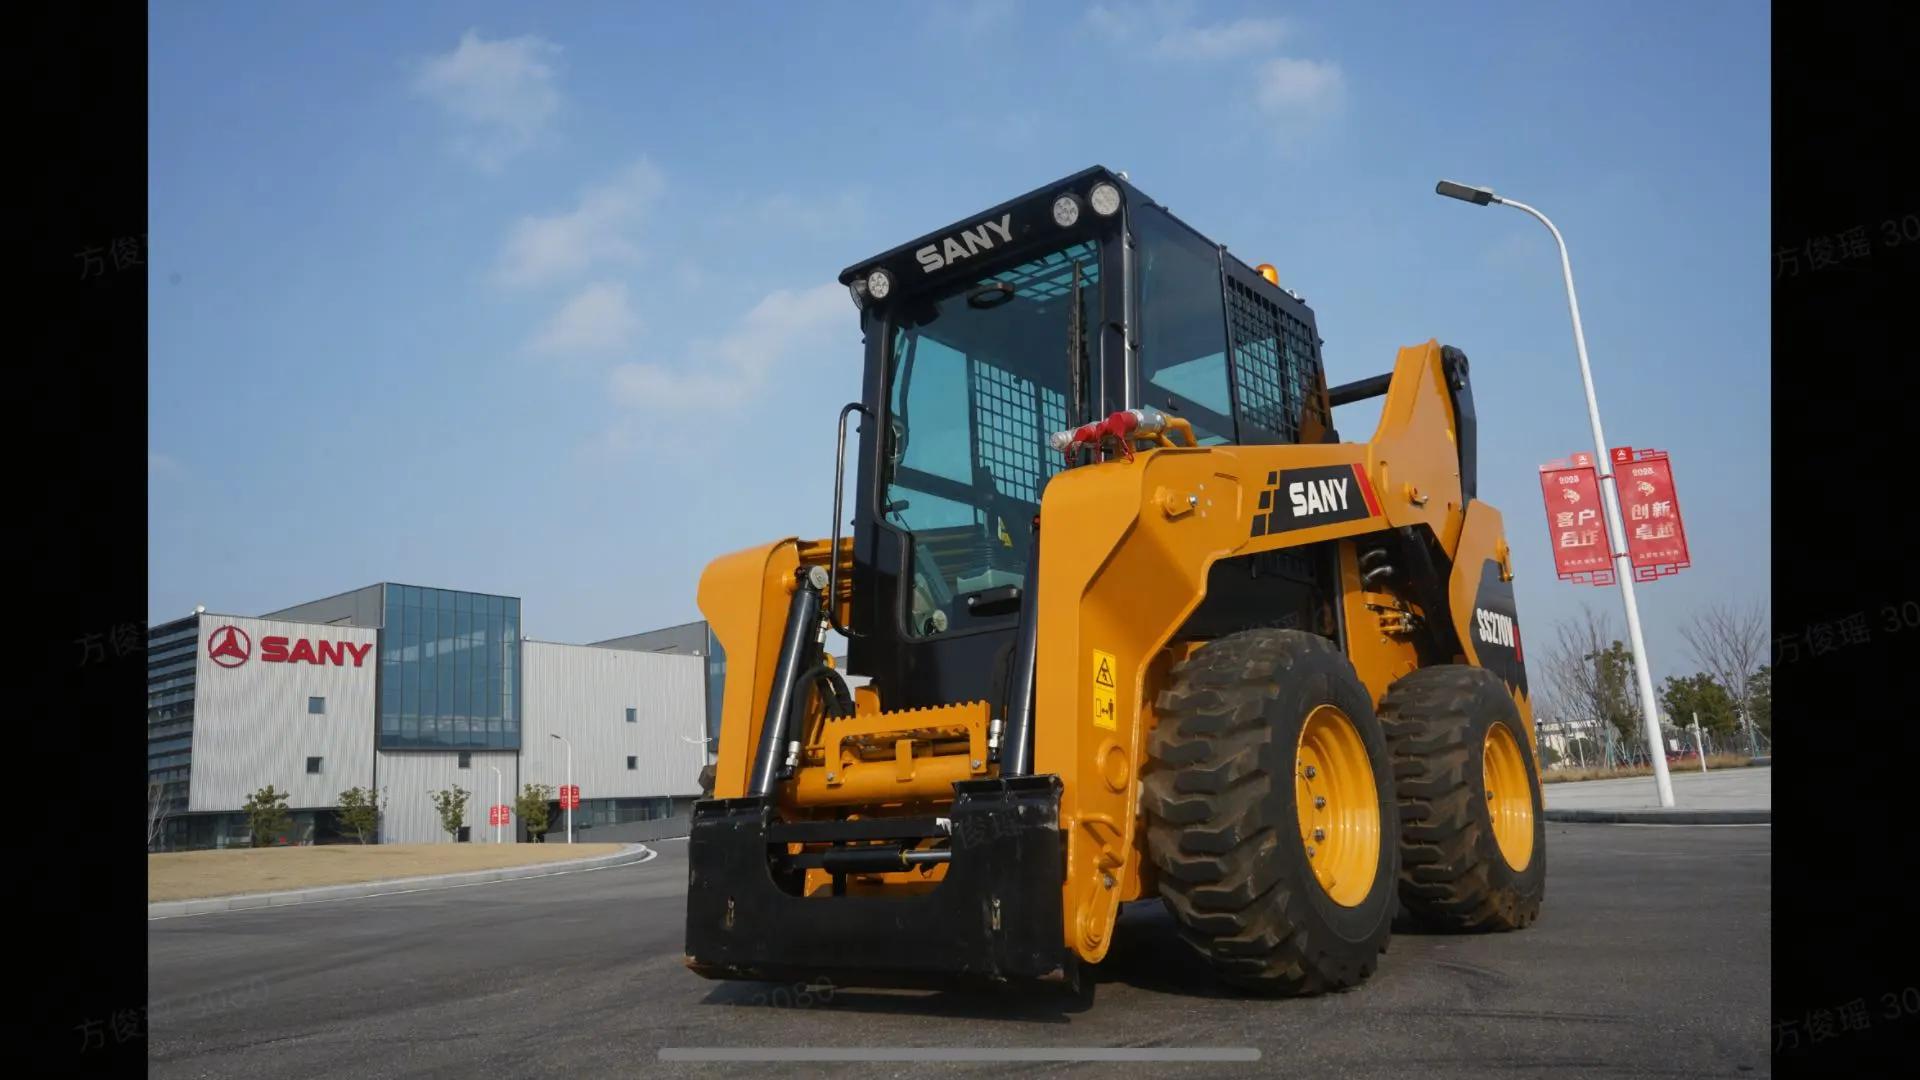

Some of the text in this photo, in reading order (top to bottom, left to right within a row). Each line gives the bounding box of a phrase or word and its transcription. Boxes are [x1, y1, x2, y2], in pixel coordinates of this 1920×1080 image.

[916, 213, 1012, 273] SANY
[1289, 478, 1348, 517] SANY
[1631, 500, 1671, 521] 创新
[1556, 509, 1596, 528] 客户
[261, 636, 372, 667] SANY
